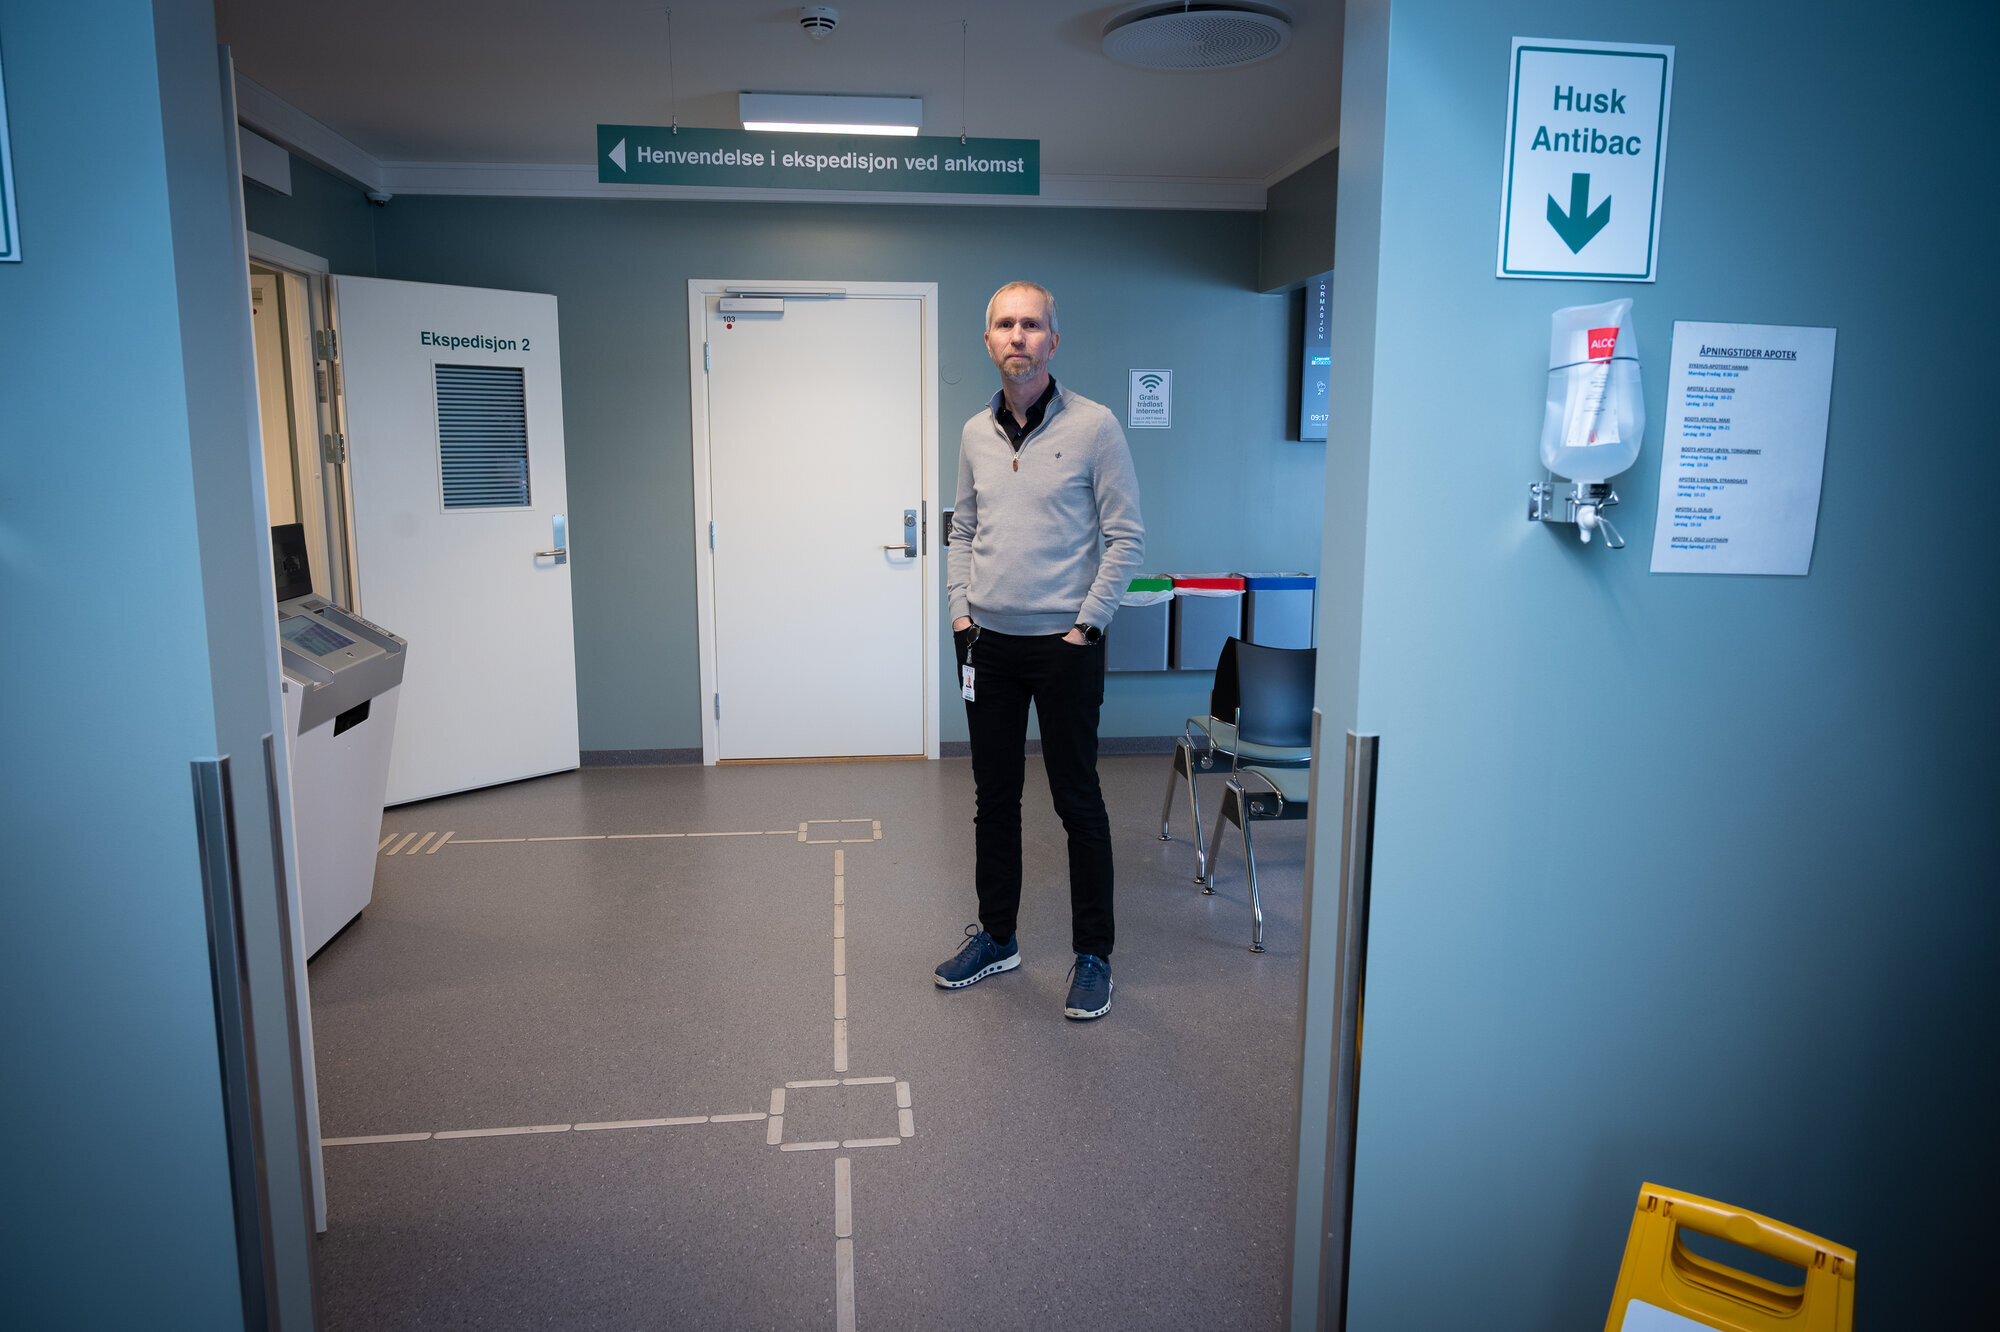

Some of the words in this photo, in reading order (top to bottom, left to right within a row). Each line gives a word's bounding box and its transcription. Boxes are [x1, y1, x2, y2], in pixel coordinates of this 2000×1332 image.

[1553, 85, 1627, 115] Husk
[1530, 125, 1642, 156] Antibac
[637, 146, 765, 166] Henvendelse
[770, 150, 776, 167] i
[782, 150, 898, 173] ekspedisjon
[904, 155, 938, 171] ved
[944, 155, 1024, 173] ankomst
[1318, 281, 1326, 340] ORMASJON
[420, 331, 517, 353] Ekspedisjon
[521, 338, 531, 351] 2
[1699, 344, 1762, 358] ÅPNINGSTIDER
[1763, 349, 1798, 360] APOTEK
